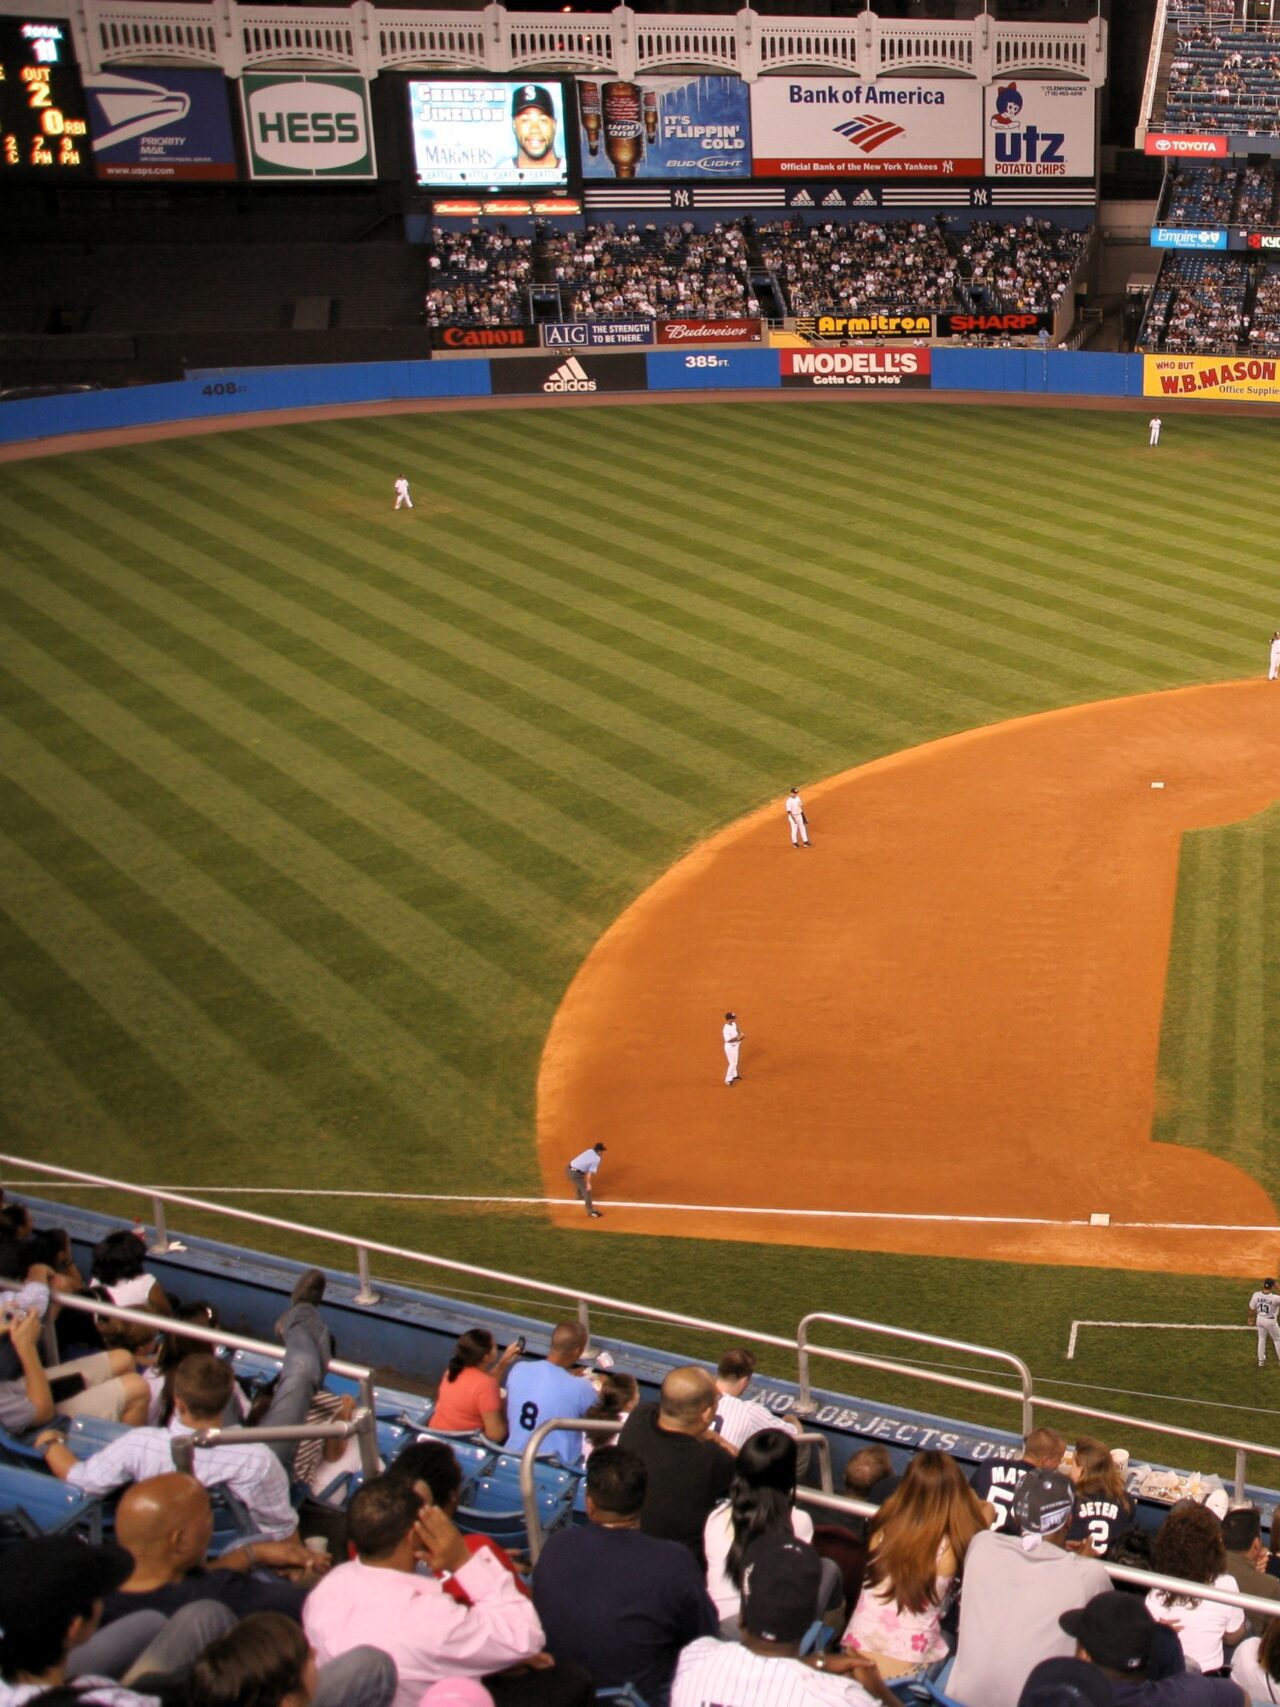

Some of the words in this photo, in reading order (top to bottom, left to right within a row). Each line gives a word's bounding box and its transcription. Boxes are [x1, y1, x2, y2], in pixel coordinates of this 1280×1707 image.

[21, 67, 51, 81] OUT
[28, 82, 52, 107] 2
[789, 85, 839, 103] Bank
[842, 86, 862, 104] of
[865, 86, 945, 105] America
[64, 120, 87, 134] RBI
[664, 115, 691, 125] IT'S
[259, 112, 360, 144] HESS
[665, 125, 740, 138] FLIPPIN'
[141, 137, 186, 146] PRIORITY
[702, 138, 745, 150] COLD
[994, 126, 1065, 163] utz
[1172, 141, 1216, 152] TOYOTA
[140, 147, 166, 155] MAIL
[666, 160, 696, 168] BUD
[703, 160, 743, 168] LIGHT
[781, 163, 811, 171] Official
[813, 163, 835, 171] Bank
[837, 163, 846, 171] of
[848, 163, 862, 171] the
[864, 163, 882, 171] New
[883, 163, 902, 171] York
[904, 163, 938, 171] Yankees
[995, 164, 1032, 176] POTATO
[1035, 164, 1066, 176] CHIPS
[106, 167, 175, 176] www.usps.com
[1158, 229, 1197, 245] Empire
[592, 325, 608, 334] THE
[609, 324, 650, 333] STRENGTH
[818, 316, 930, 332] Armitron
[950, 315, 1037, 330] SHARP
[443, 327, 525, 346] Canon
[548, 326, 586, 344] AIG
[593, 335, 603, 343] TO
[605, 334, 616, 342] BE
[665, 324, 748, 339] Budweiser
[685, 356, 717, 368] 385
[793, 353, 918, 373] MODELL'S
[1155, 362, 1176, 370] WHO
[1178, 361, 1194, 370] BUT
[543, 379, 597, 393] adidas
[813, 375, 845, 385] Gotta
[846, 375, 862, 384] Go
[863, 375, 876, 384] To
[878, 375, 900, 384] Mo's
[202, 383, 237, 397] 408
[1219, 385, 1244, 394] Office
[520, 1401, 538, 1431] 8
[752, 1389, 794, 1412] NO
[816, 1405, 960, 1451] OBJECTS
[1079, 1502, 1119, 1519] JETER
[1088, 1520, 1110, 1555] 2
